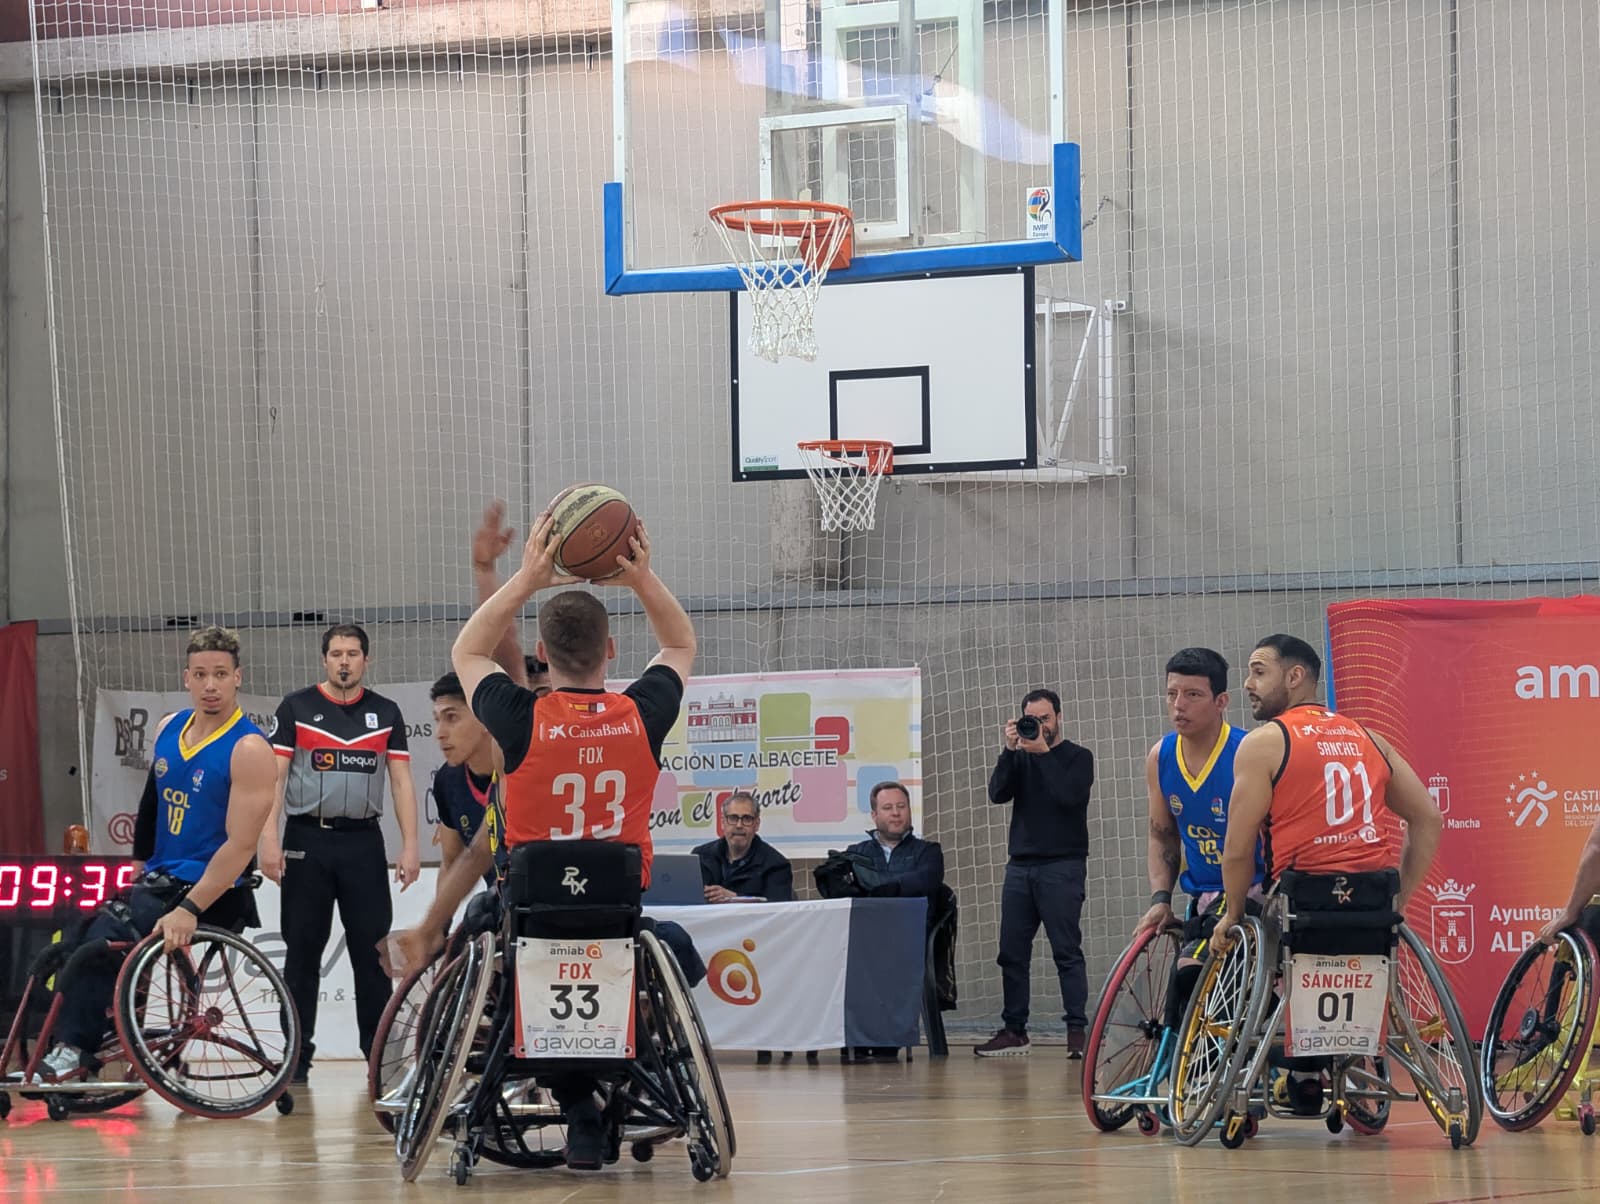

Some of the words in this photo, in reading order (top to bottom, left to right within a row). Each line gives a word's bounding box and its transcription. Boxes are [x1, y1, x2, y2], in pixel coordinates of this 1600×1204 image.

[568, 721, 632, 739] CaixaBank
[578, 746, 604, 765] FOX
[719, 753, 744, 770] DE
[749, 750, 837, 768] ALBACETE
[162, 787, 191, 809] COL
[1323, 760, 1374, 827] 01
[550, 769, 627, 841] 33
[692, 791, 714, 823] el
[1563, 801, 1580, 814] LA
[167, 804, 185, 836] 18
[1447, 819, 1481, 830] Mancha
[550, 945, 585, 956] amiab
[558, 962, 593, 980] FOX
[1315, 959, 1346, 968] amiab
[1302, 970, 1373, 989] SÁNCHEZ
[549, 984, 600, 1020] 33
[1317, 992, 1355, 1022] 01
[534, 1036, 616, 1053] gaviota
[1300, 1035, 1370, 1052] gaviota
